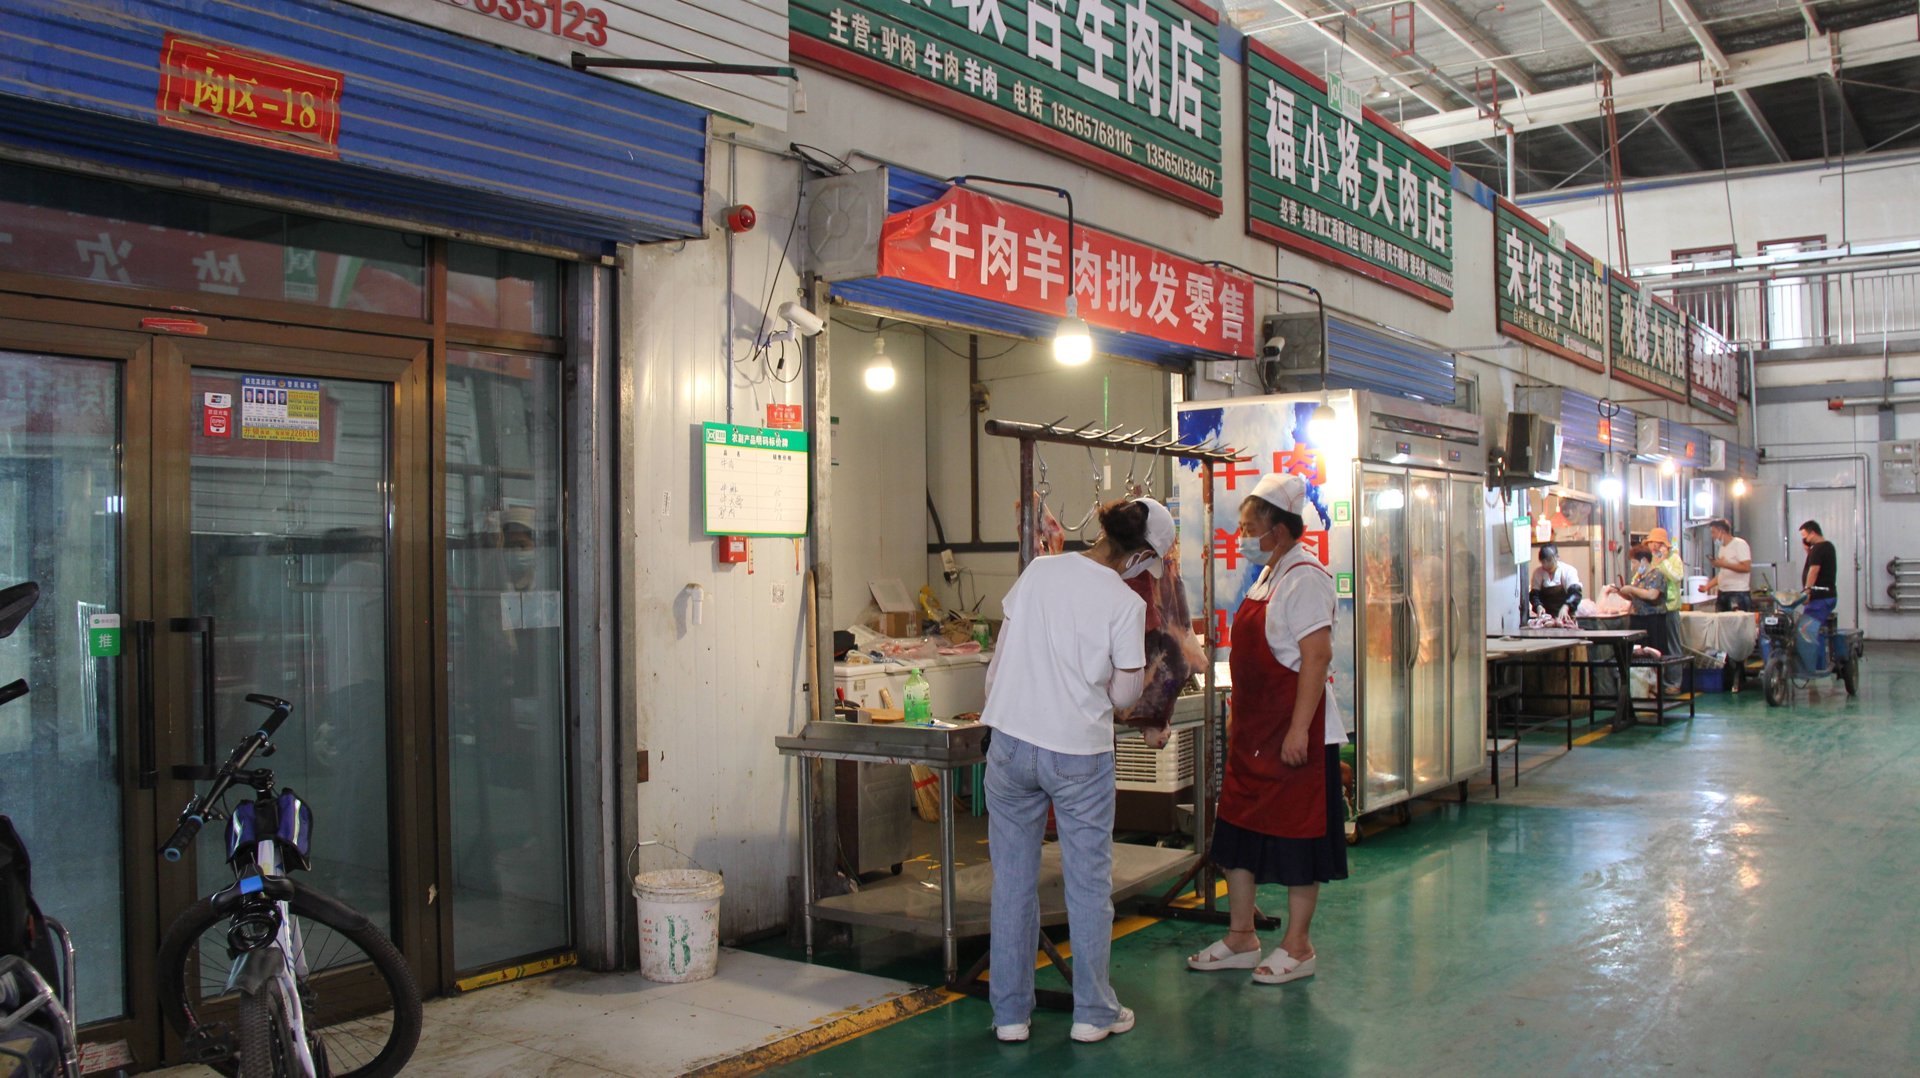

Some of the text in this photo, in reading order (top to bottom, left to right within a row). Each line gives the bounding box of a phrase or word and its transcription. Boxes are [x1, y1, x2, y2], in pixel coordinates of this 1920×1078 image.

[193, 65, 317, 130] 肉区-18
[922, 43, 960, 86] 牛肉
[963, 57, 999, 101] 羊肉
[1012, 80, 1044, 120] 电话
[1051, 101, 1134, 156] 13565768116
[1145, 142, 1216, 191] 13565033467
[1265, 78, 1447, 254] 福小将大肉店
[929, 202, 1246, 343] 牛肉羊肉批发零售
[98, 633, 113, 649] 推
